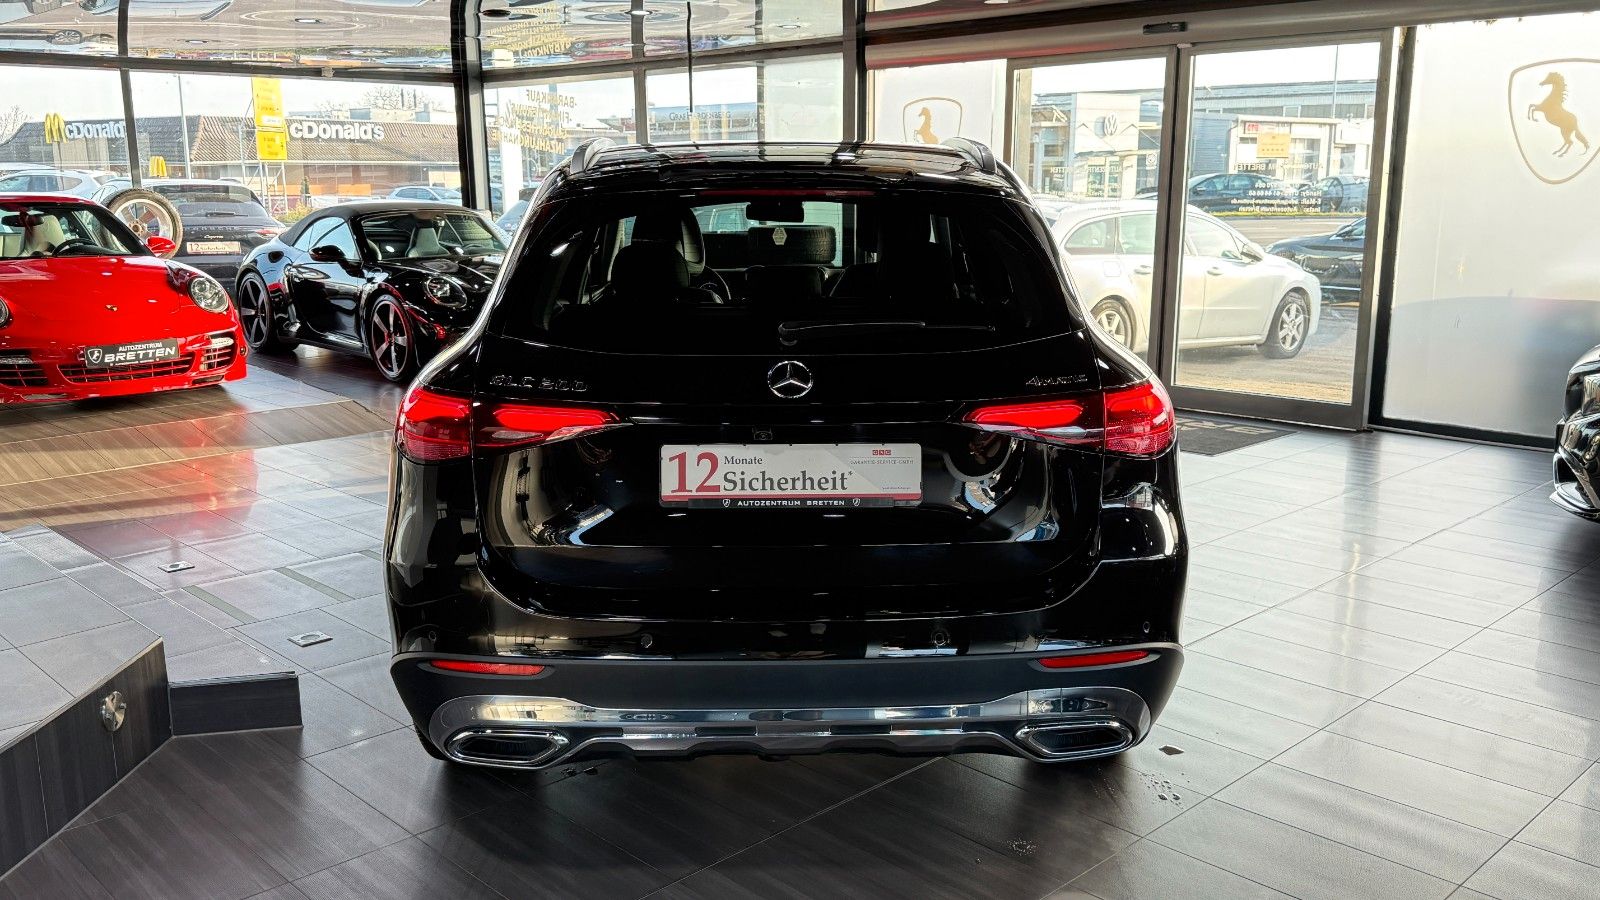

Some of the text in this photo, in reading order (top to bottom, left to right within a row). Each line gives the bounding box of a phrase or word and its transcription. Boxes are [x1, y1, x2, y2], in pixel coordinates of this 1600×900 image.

[289, 121, 385, 140] cDonald's
[103, 347, 176, 363] BRETTEN
[118, 342, 163, 352] AUTOZENTRUM
[724, 456, 763, 465] Monate
[668, 451, 721, 494] 12
